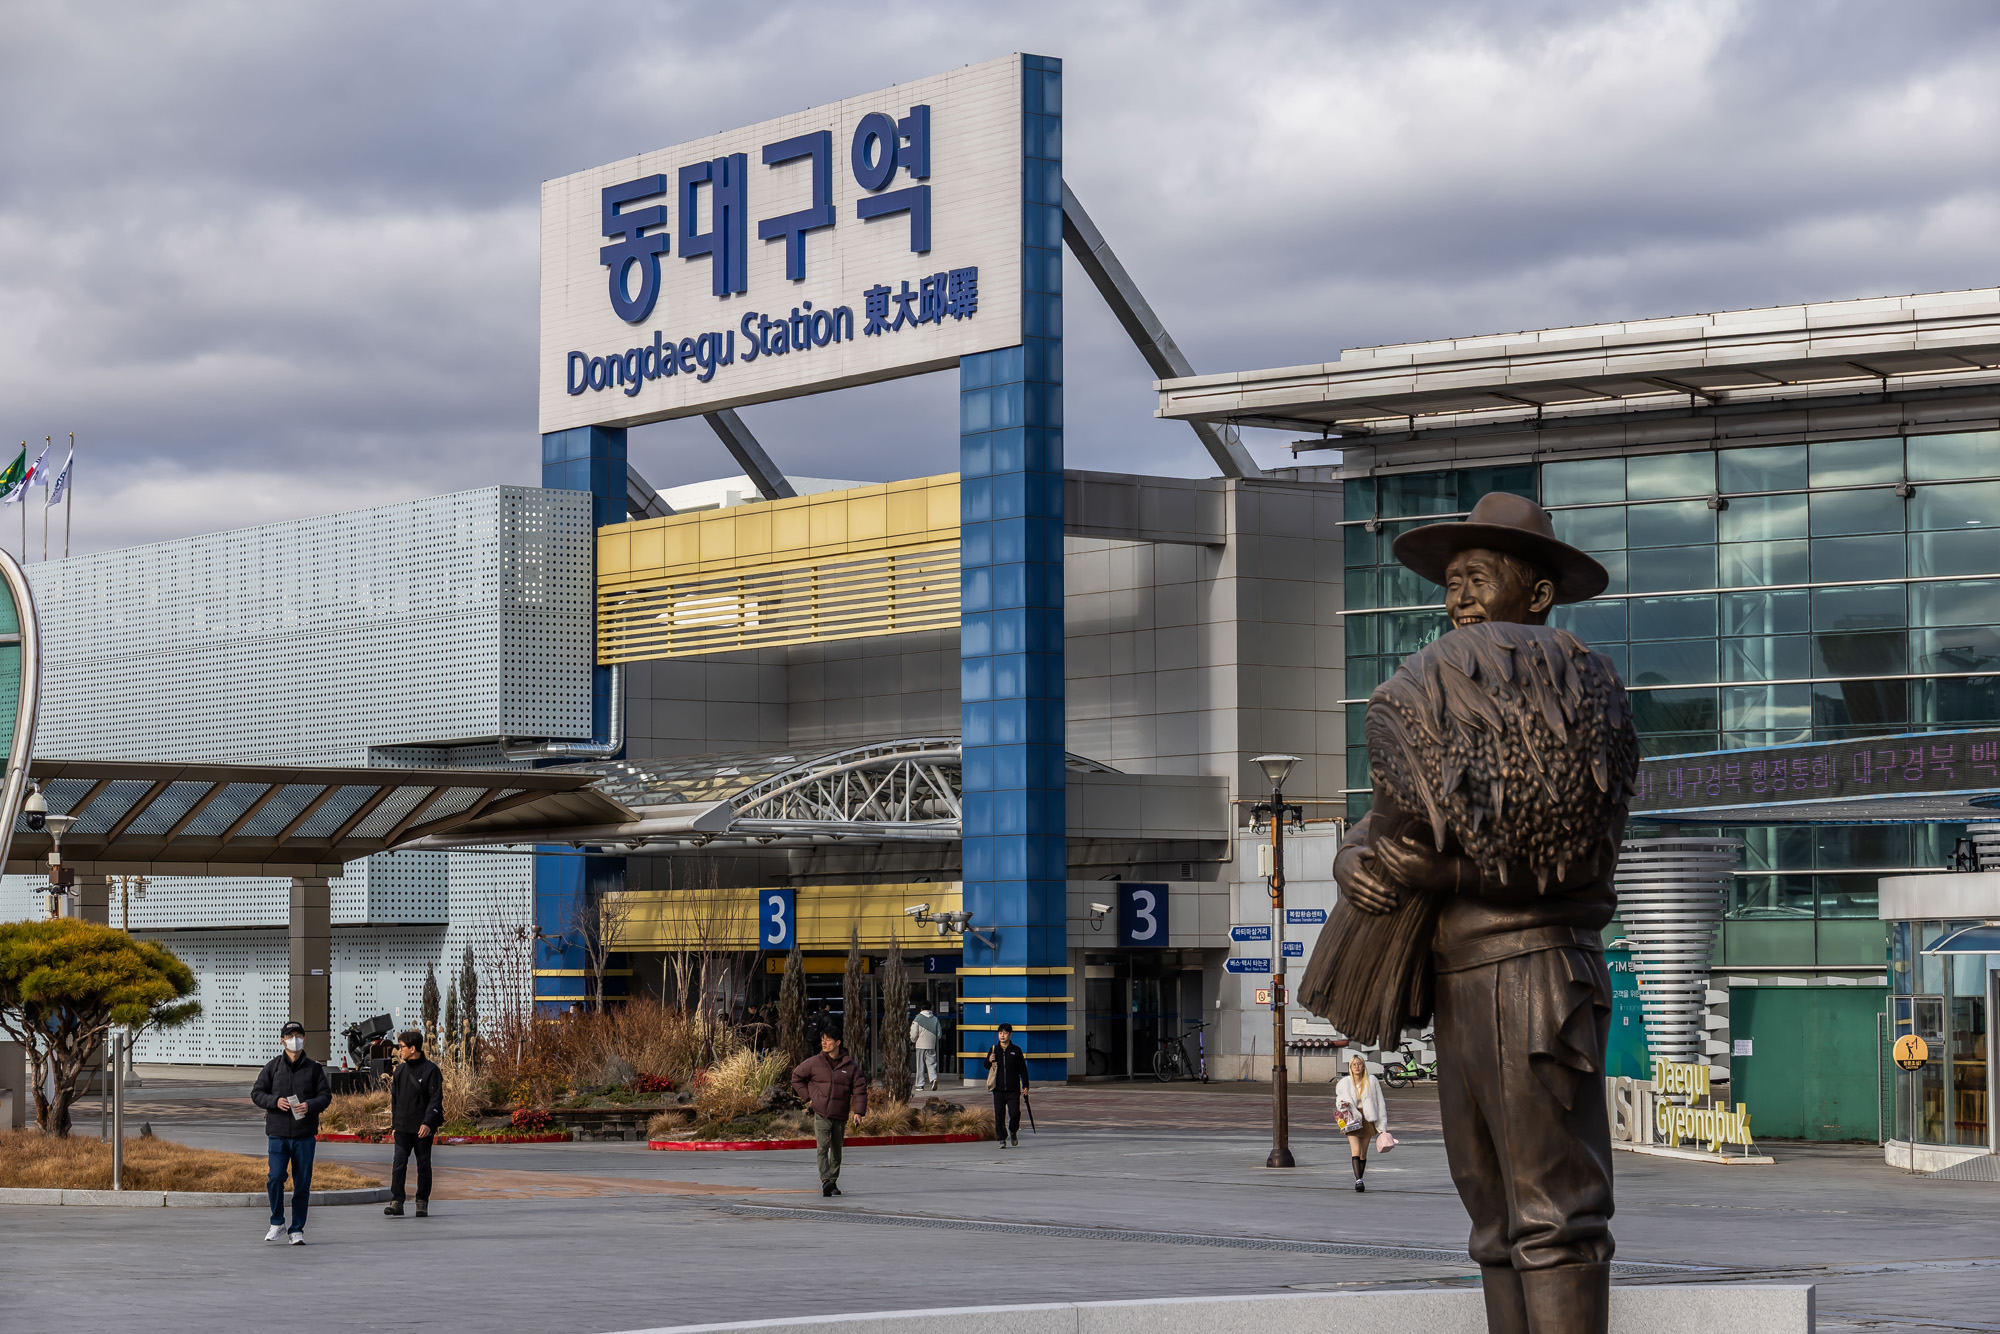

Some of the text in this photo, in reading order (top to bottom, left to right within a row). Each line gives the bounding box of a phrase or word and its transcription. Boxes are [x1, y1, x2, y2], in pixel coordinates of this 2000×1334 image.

[600, 104, 932, 323] 동대구역
[863, 265, 979, 335] 東大邱驛
[566, 300, 854, 397] Dongdaegu Station
[1668, 762, 1743, 799] 대구경북
[1750, 754, 1837, 793] 행정통합!
[1853, 744, 1956, 784] 대구경북
[1971, 741, 1997, 777] 백
[767, 895, 787, 945] 3
[1131, 889, 1158, 941] 3
[771, 959, 776, 972] 3
[928, 957, 936, 972] 3
[1252, 959, 1268, 967] 타는곳
[1615, 961, 1644, 973] iM뱅
[1613, 990, 1629, 999] 고객을
[1656, 1057, 1710, 1105] Daegu
[1606, 1076, 1753, 1153] ISIT Gyeongbuk
